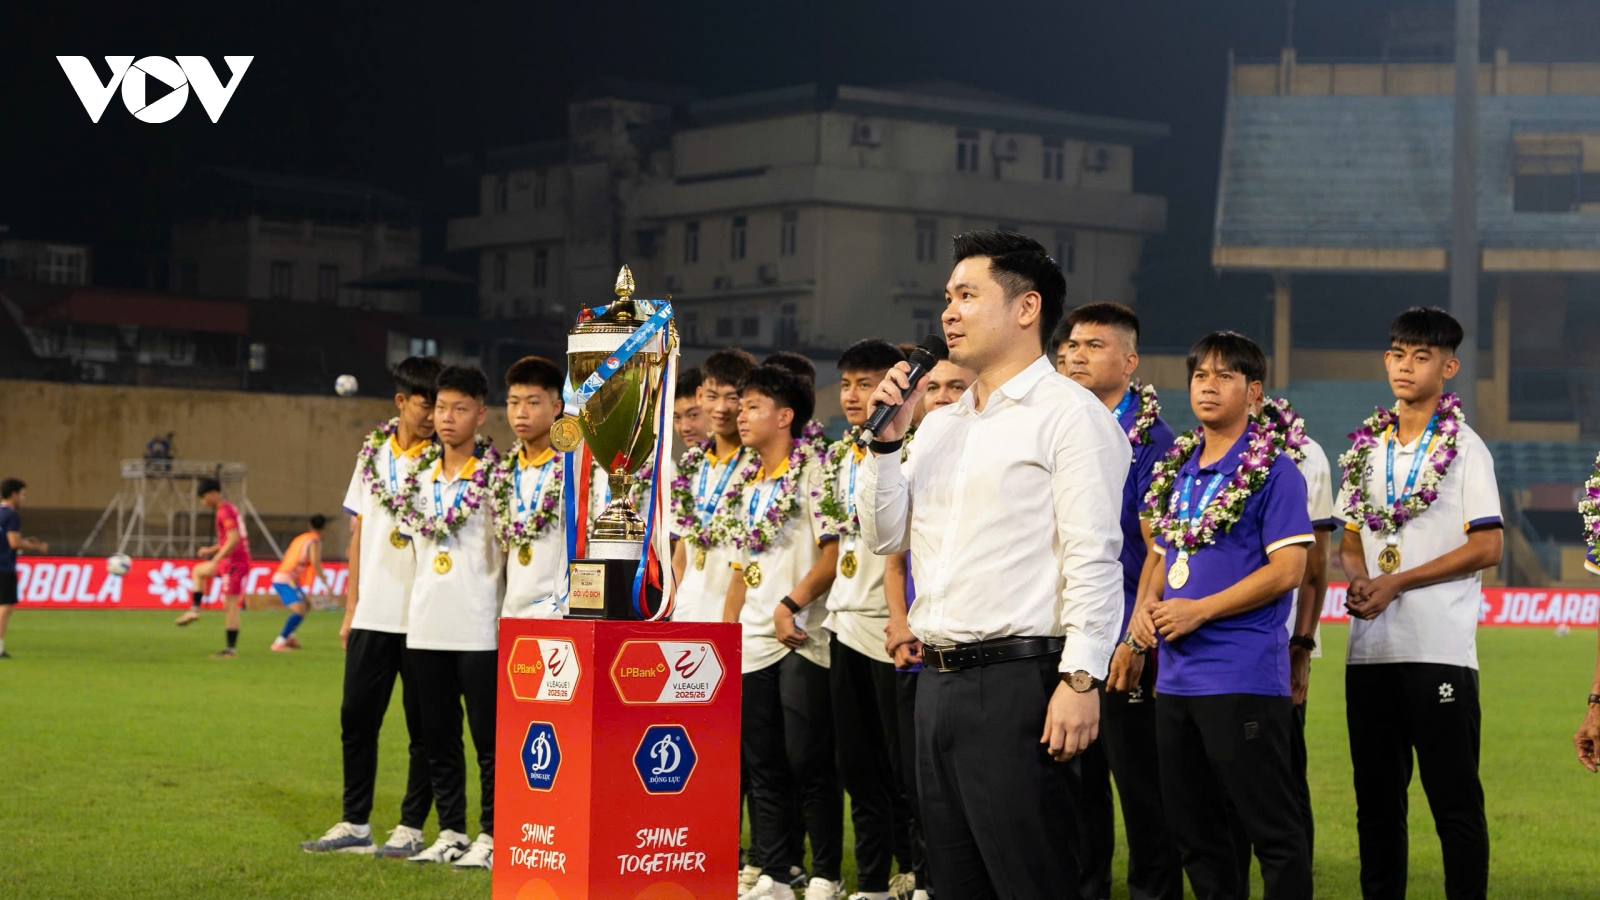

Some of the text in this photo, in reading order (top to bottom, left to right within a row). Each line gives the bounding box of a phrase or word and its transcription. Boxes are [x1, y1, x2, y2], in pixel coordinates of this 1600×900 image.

[658, 303, 672, 319] VF
[513, 663, 537, 674] LPBank
[620, 667, 656, 678] LPBank
[672, 682, 705, 690] V.LEAGUE
[547, 689, 568, 697] 2025/26
[675, 691, 706, 699] 2025/26
[521, 823, 556, 845] SHINE
[636, 827, 689, 849] SHINE
[509, 846, 567, 875] TOGETHER
[617, 852, 706, 875] TOGETHER
